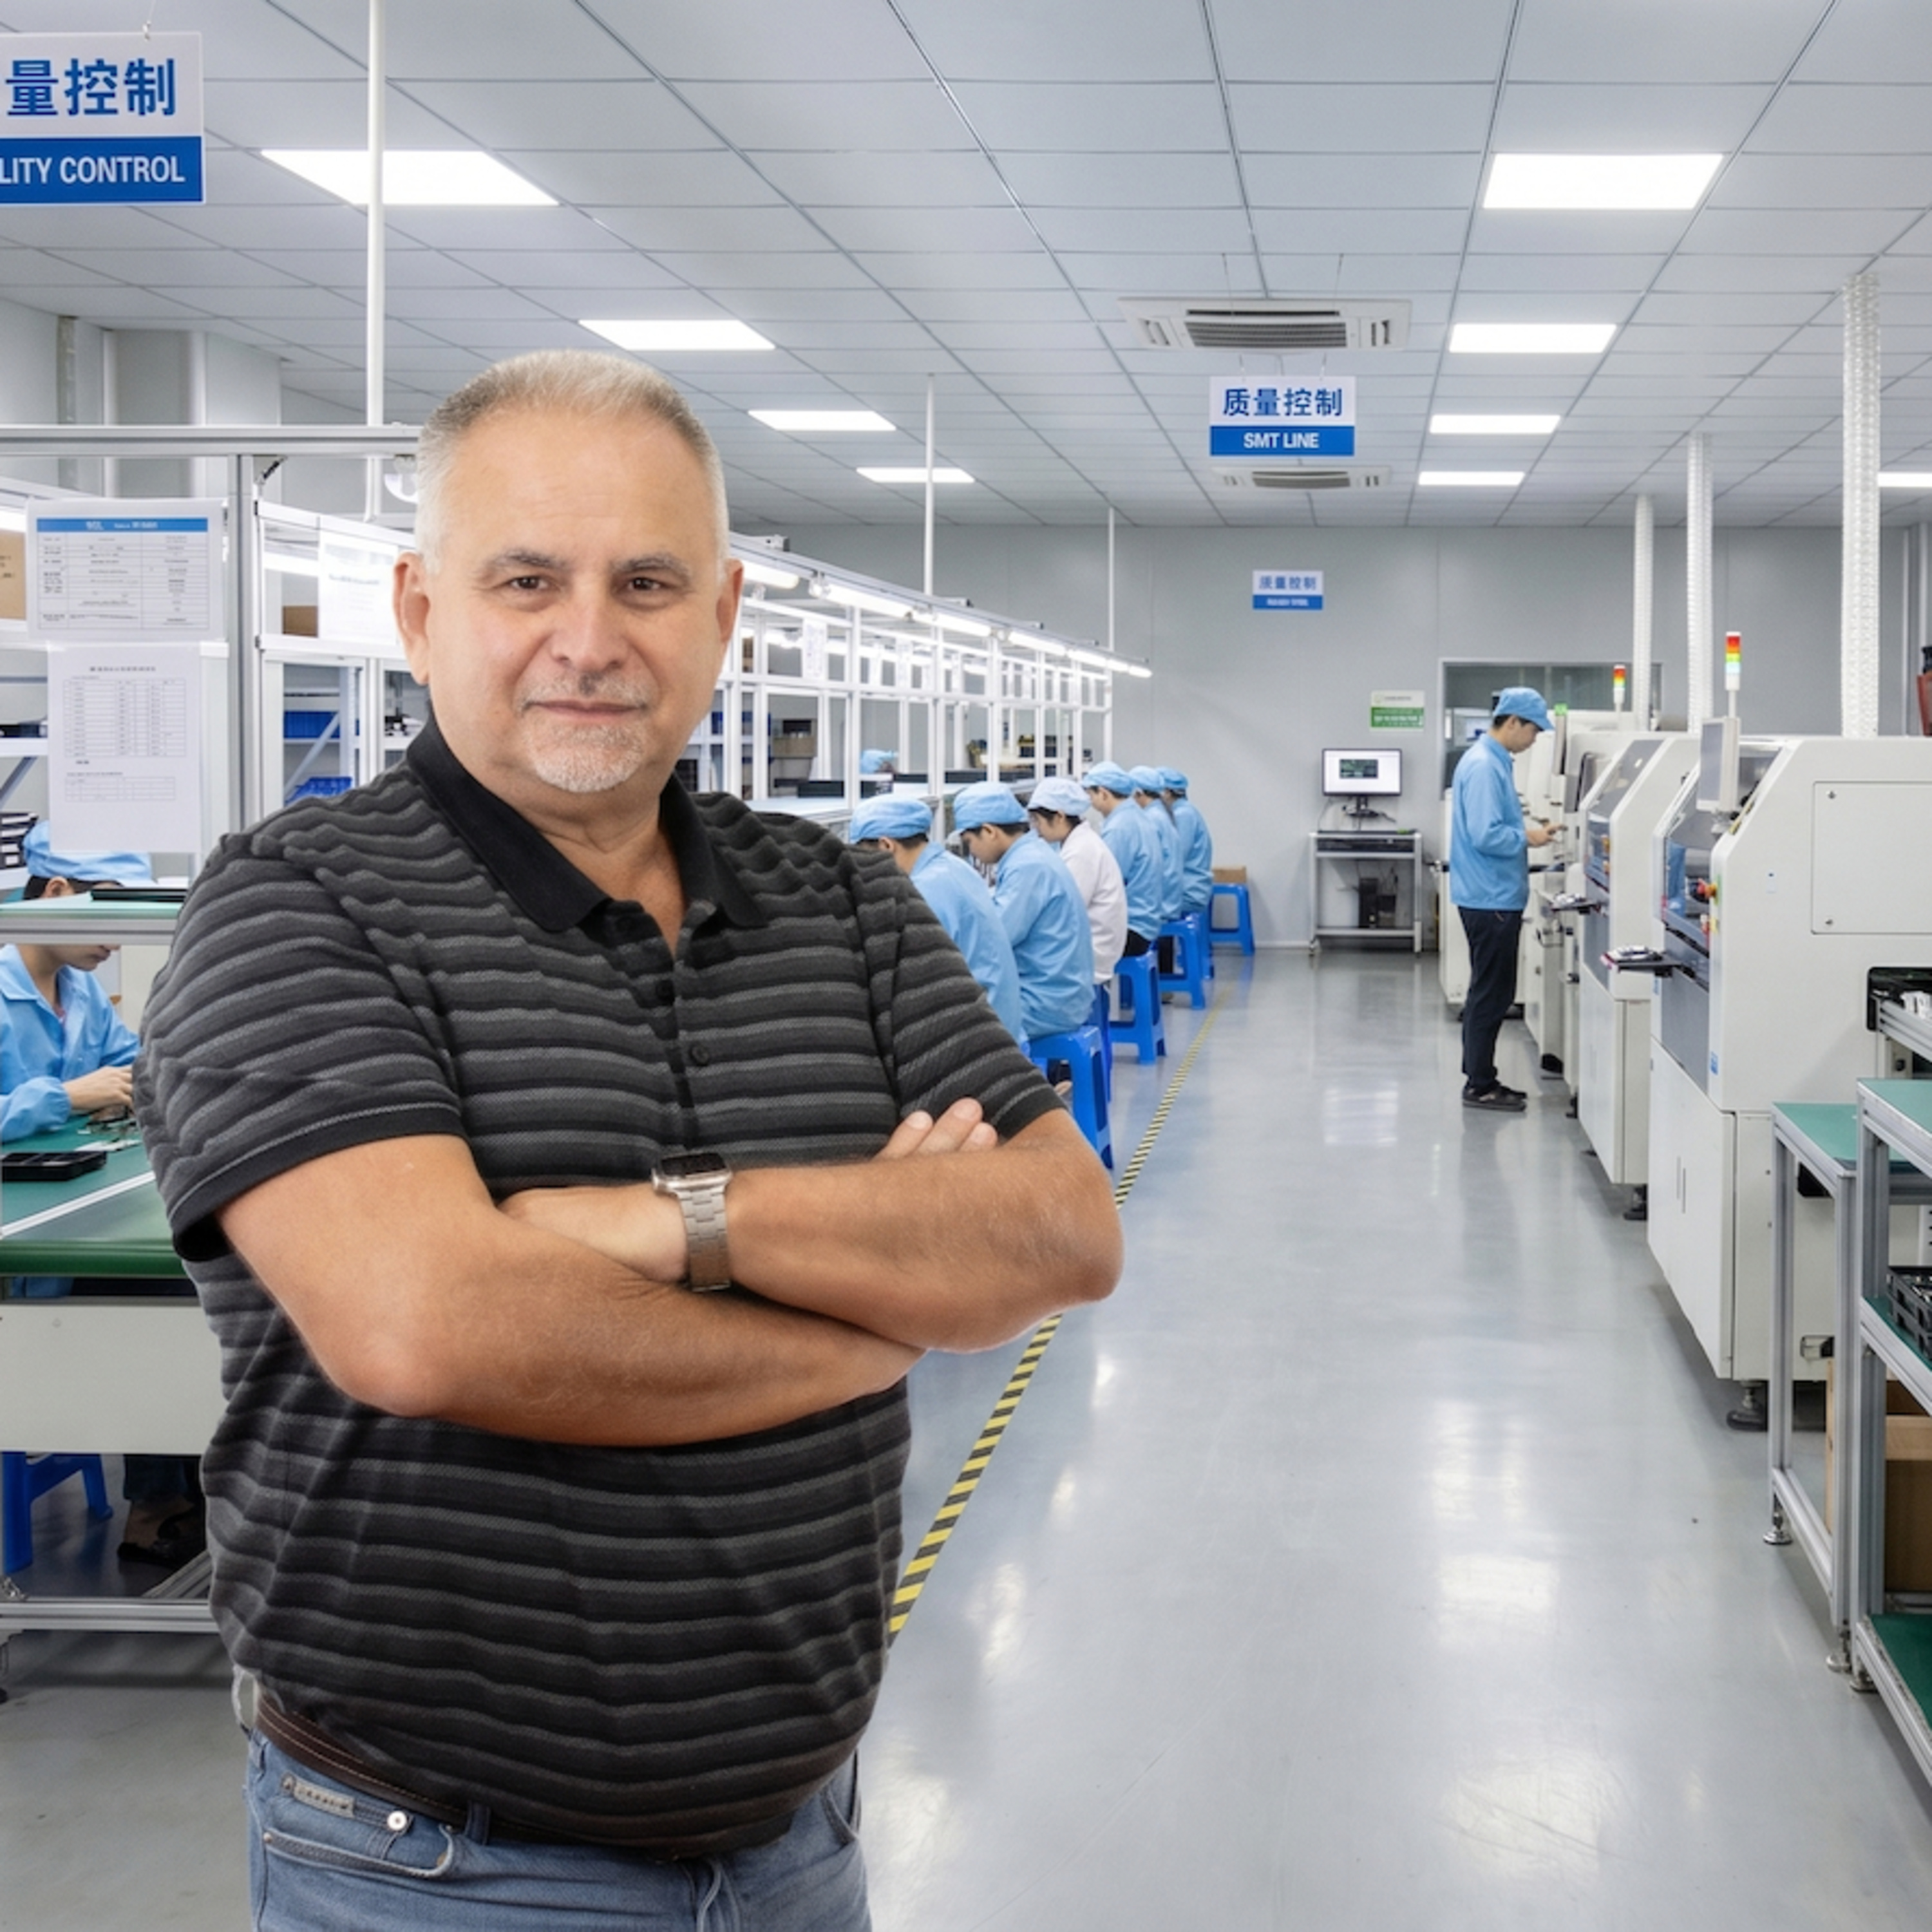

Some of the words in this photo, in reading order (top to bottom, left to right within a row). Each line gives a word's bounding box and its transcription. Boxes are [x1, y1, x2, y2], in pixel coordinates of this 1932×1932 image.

[5, 59, 175, 116] 量控制
[59, 156, 185, 184] CONTROL
[1224, 388, 1343, 416] 质量控制
[1244, 432, 1280, 448] SMT
[1283, 432, 1320, 448] LINE
